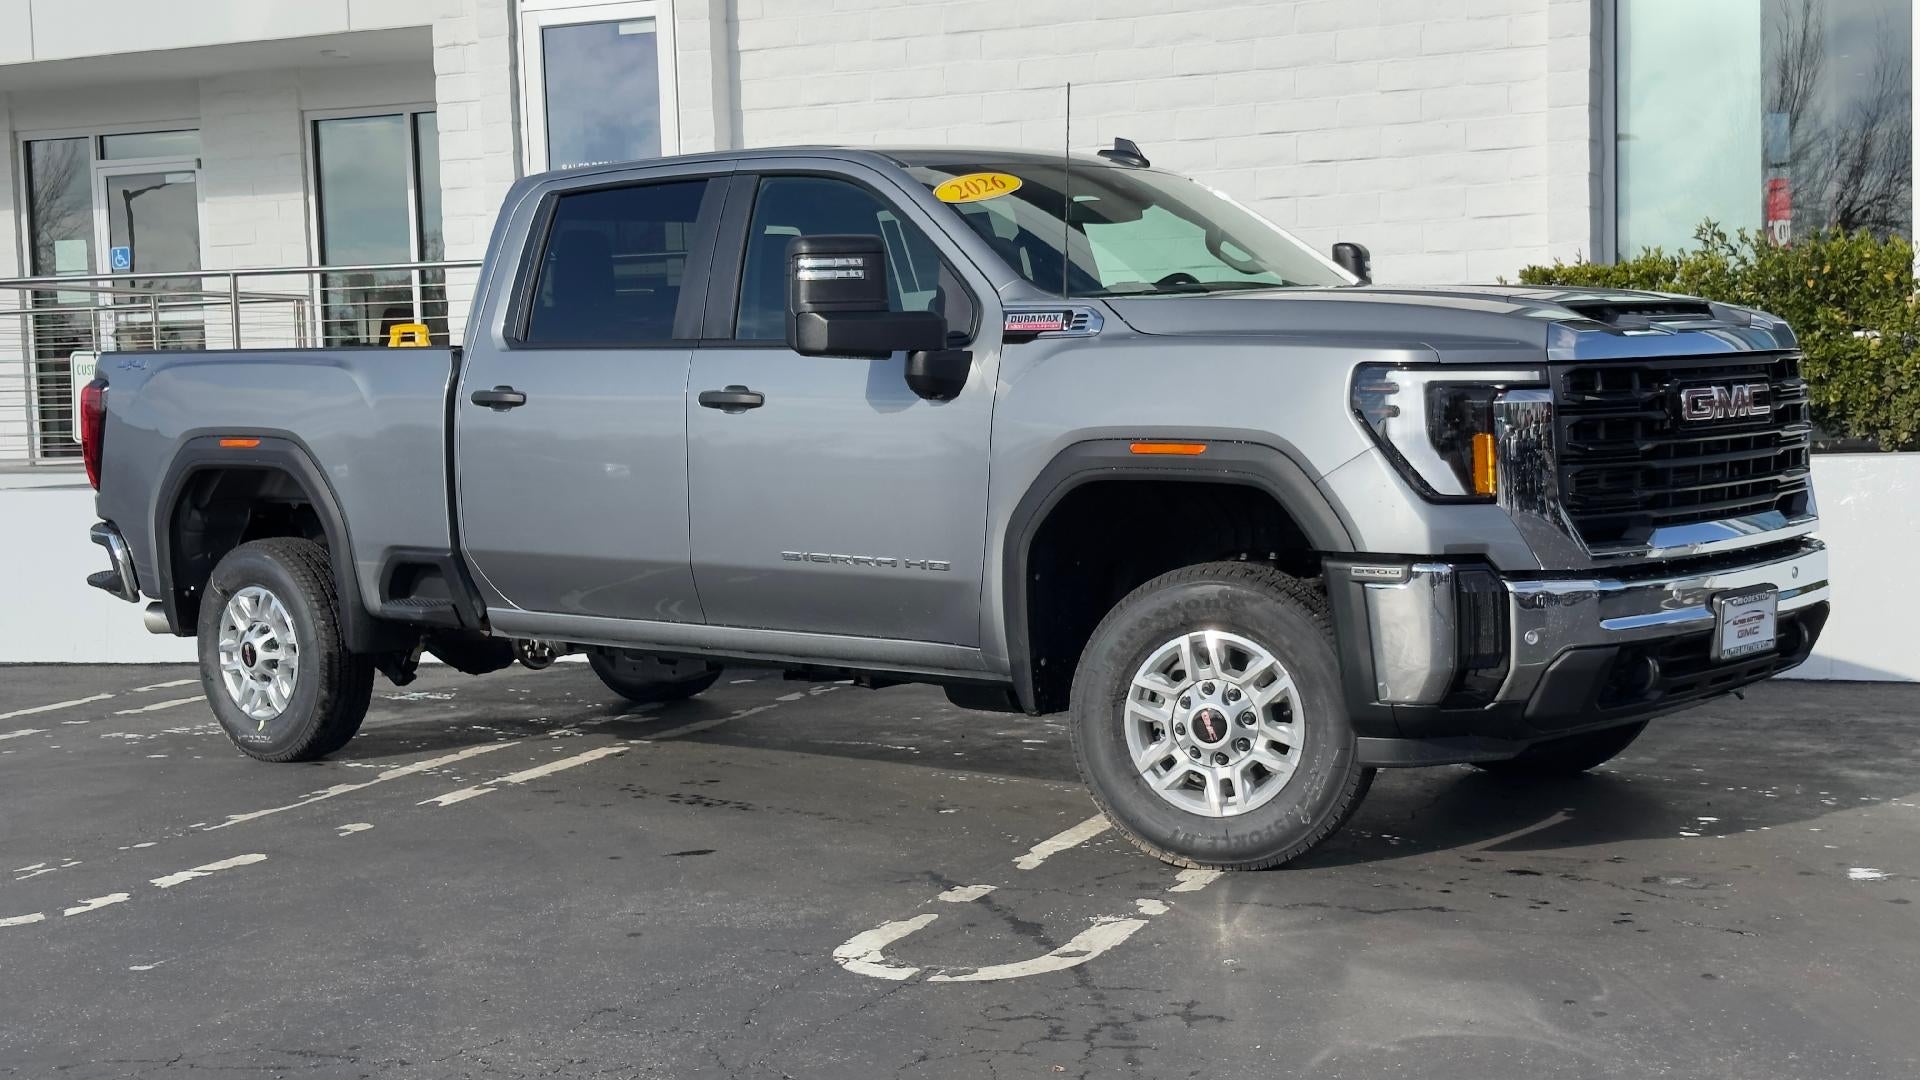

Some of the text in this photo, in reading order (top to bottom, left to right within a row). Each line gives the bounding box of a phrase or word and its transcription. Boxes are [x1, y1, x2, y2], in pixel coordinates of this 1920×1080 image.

[950, 175, 1006, 200] 2026
[1010, 314, 1060, 324] DURAMAX
[1681, 383, 1771, 421] GMC
[782, 551, 951, 572] SIERRA HD
[1737, 625, 1760, 639] GMC
